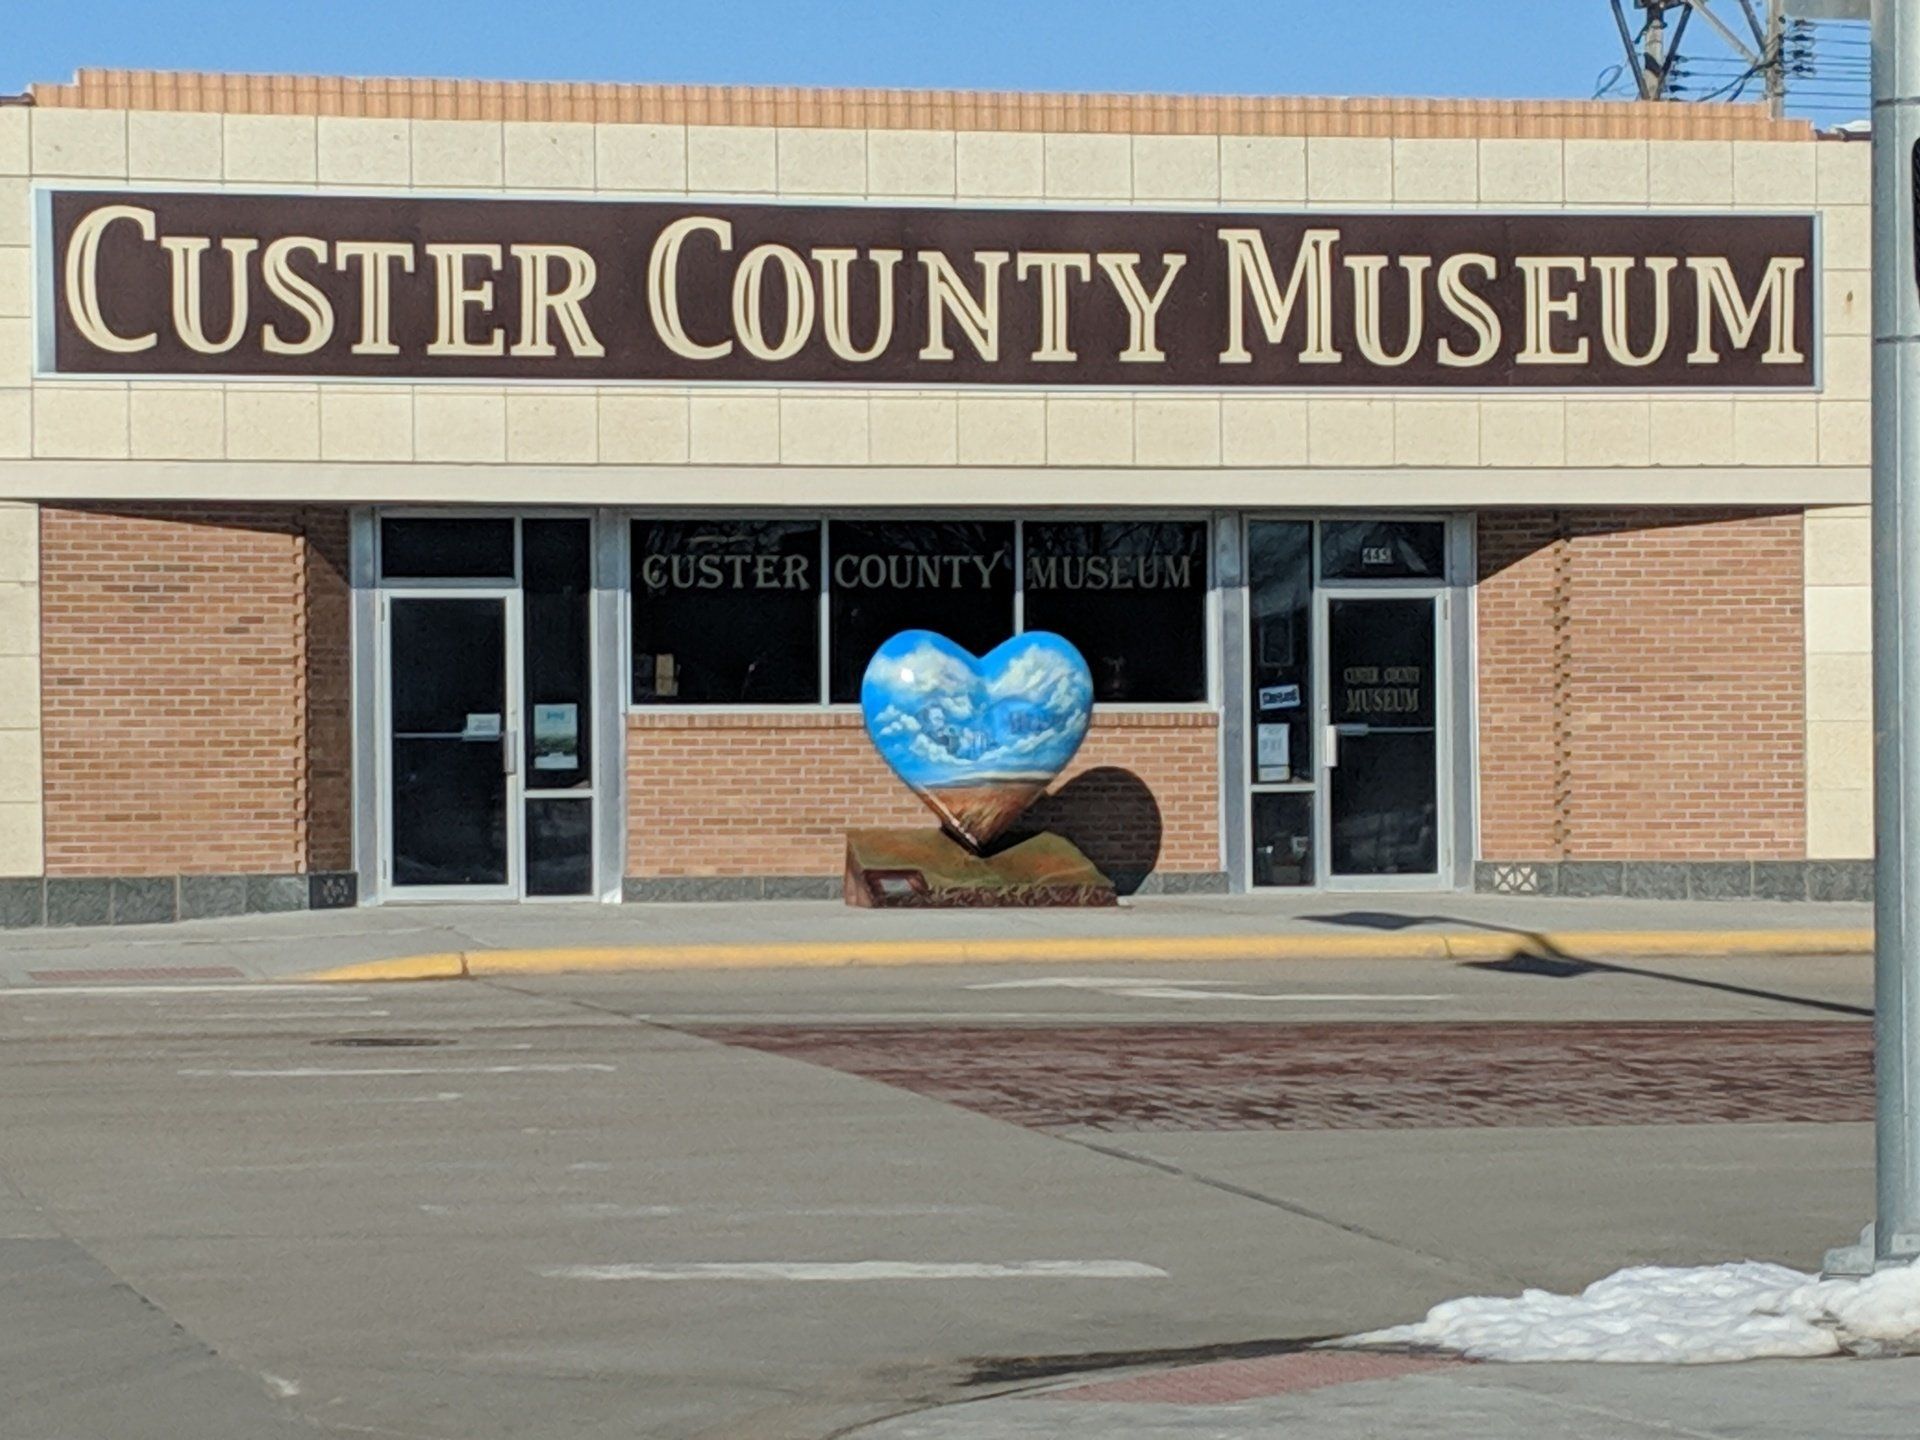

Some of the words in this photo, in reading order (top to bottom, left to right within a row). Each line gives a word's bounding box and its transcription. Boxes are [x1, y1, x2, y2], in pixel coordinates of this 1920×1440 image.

[65, 204, 605, 358] CUSTER
[647, 216, 1188, 363] COUNTY
[1217, 228, 1805, 367] MUSEUM
[642, 553, 811, 591] CUSTER
[833, 550, 1006, 589] COUNTY
[1028, 554, 1192, 590] MUSEUM
[1345, 687, 1420, 713] MUSEUM
